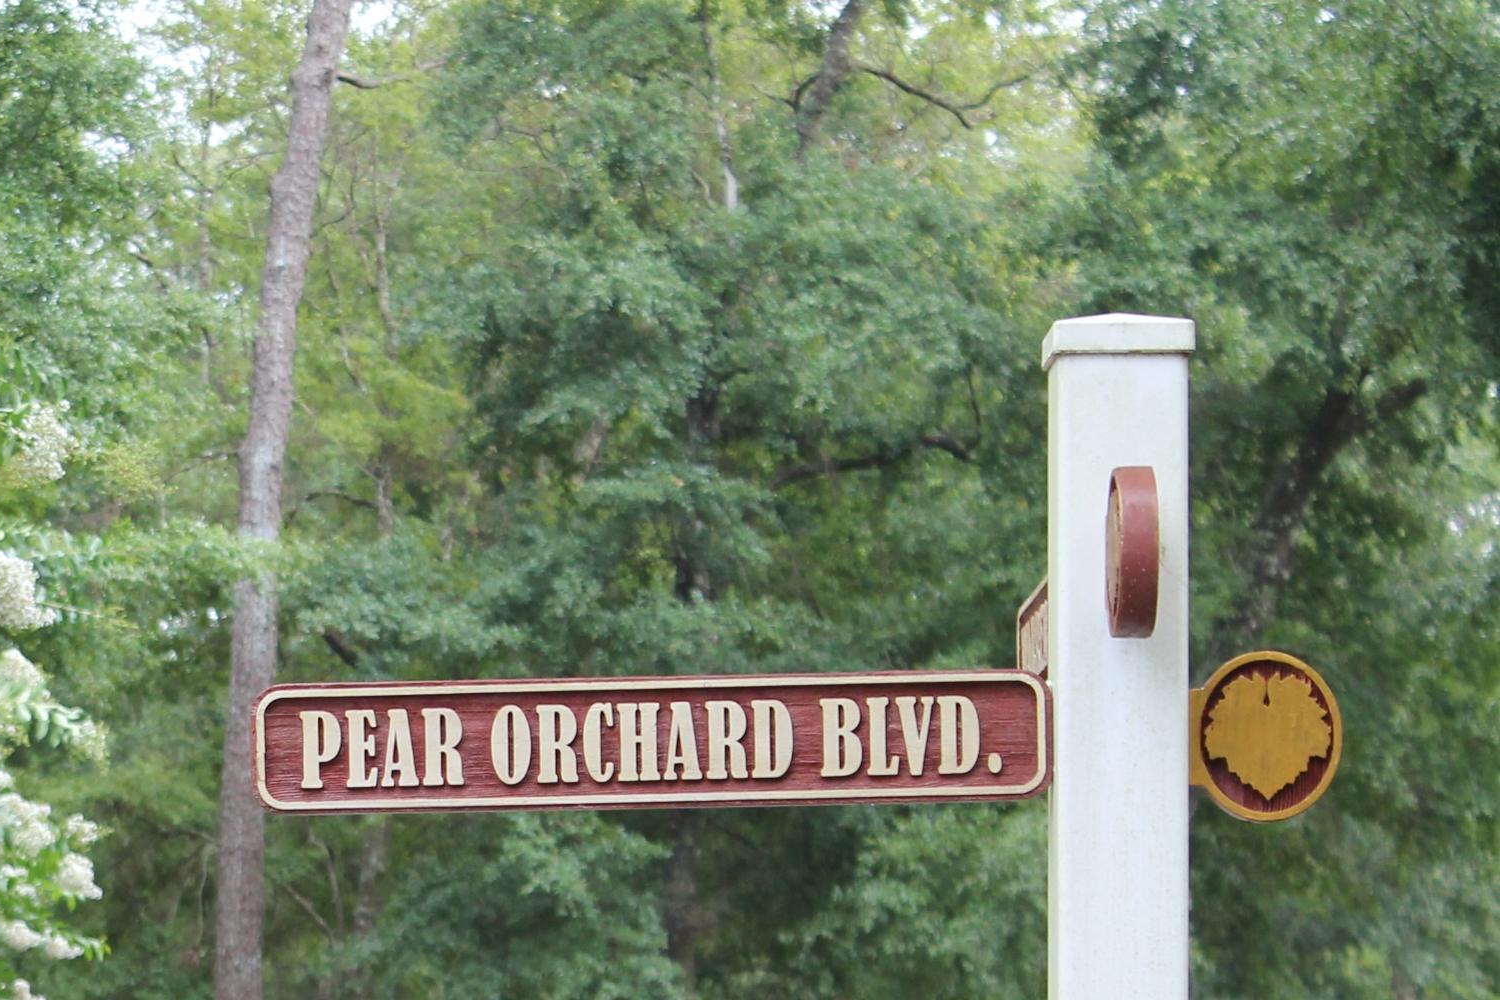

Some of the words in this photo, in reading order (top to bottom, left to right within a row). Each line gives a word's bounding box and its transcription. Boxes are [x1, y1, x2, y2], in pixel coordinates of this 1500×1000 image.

[300, 707, 465, 789] PEAR
[490, 700, 793, 785] ORCHARD
[819, 696, 1004, 778] BLVD.
